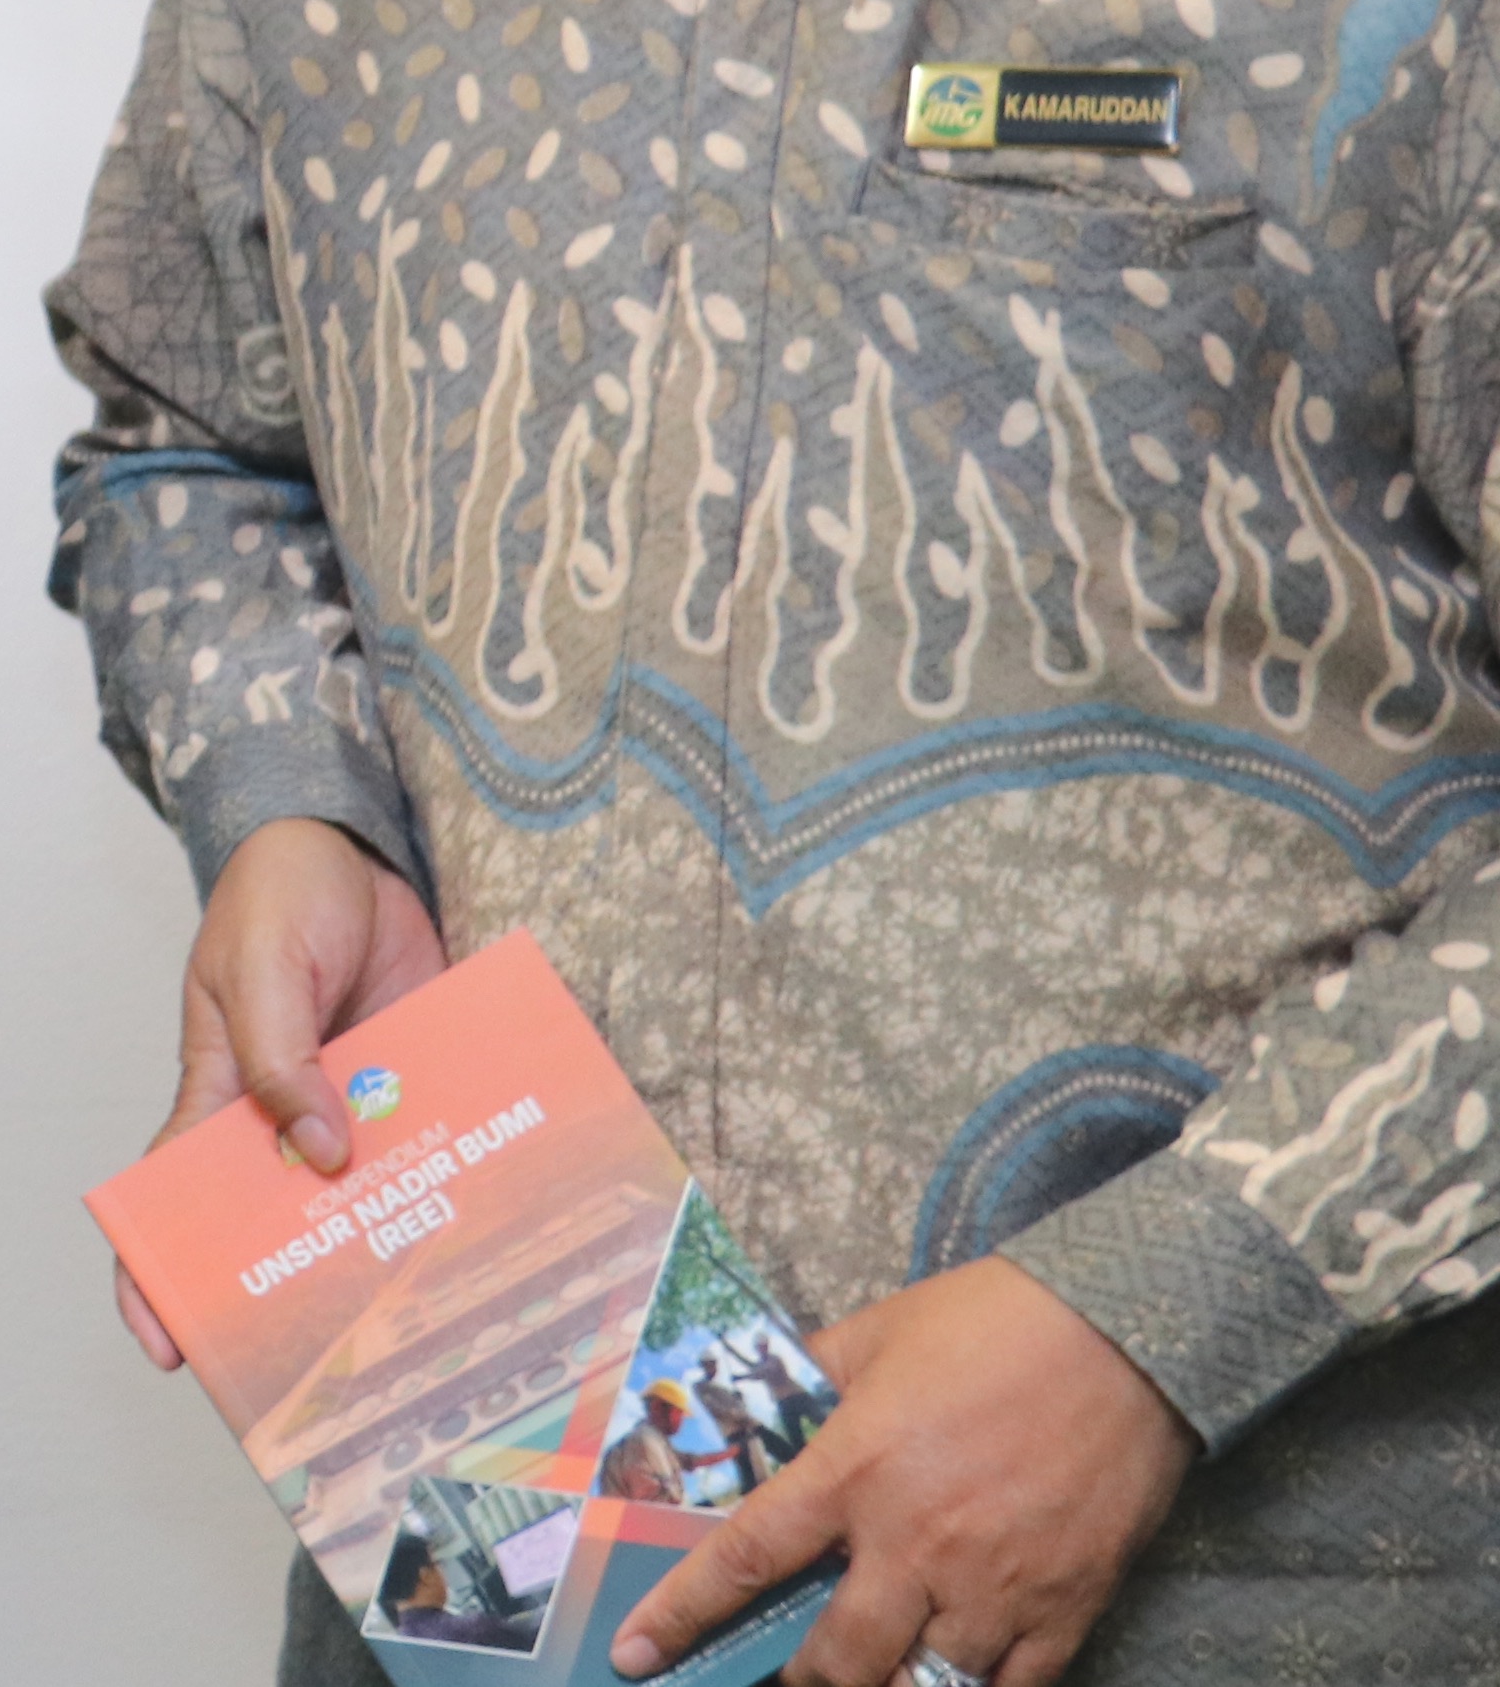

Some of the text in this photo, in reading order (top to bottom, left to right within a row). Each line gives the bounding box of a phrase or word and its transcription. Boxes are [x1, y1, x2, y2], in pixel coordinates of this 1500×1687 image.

[1004, 93, 1169, 125] KAMARUDDAN
[240, 1095, 547, 1296] UNSUR NADIR BUMI
[303, 1120, 451, 1220] KOMPENDIUM
[366, 1189, 456, 1262] (REE)
